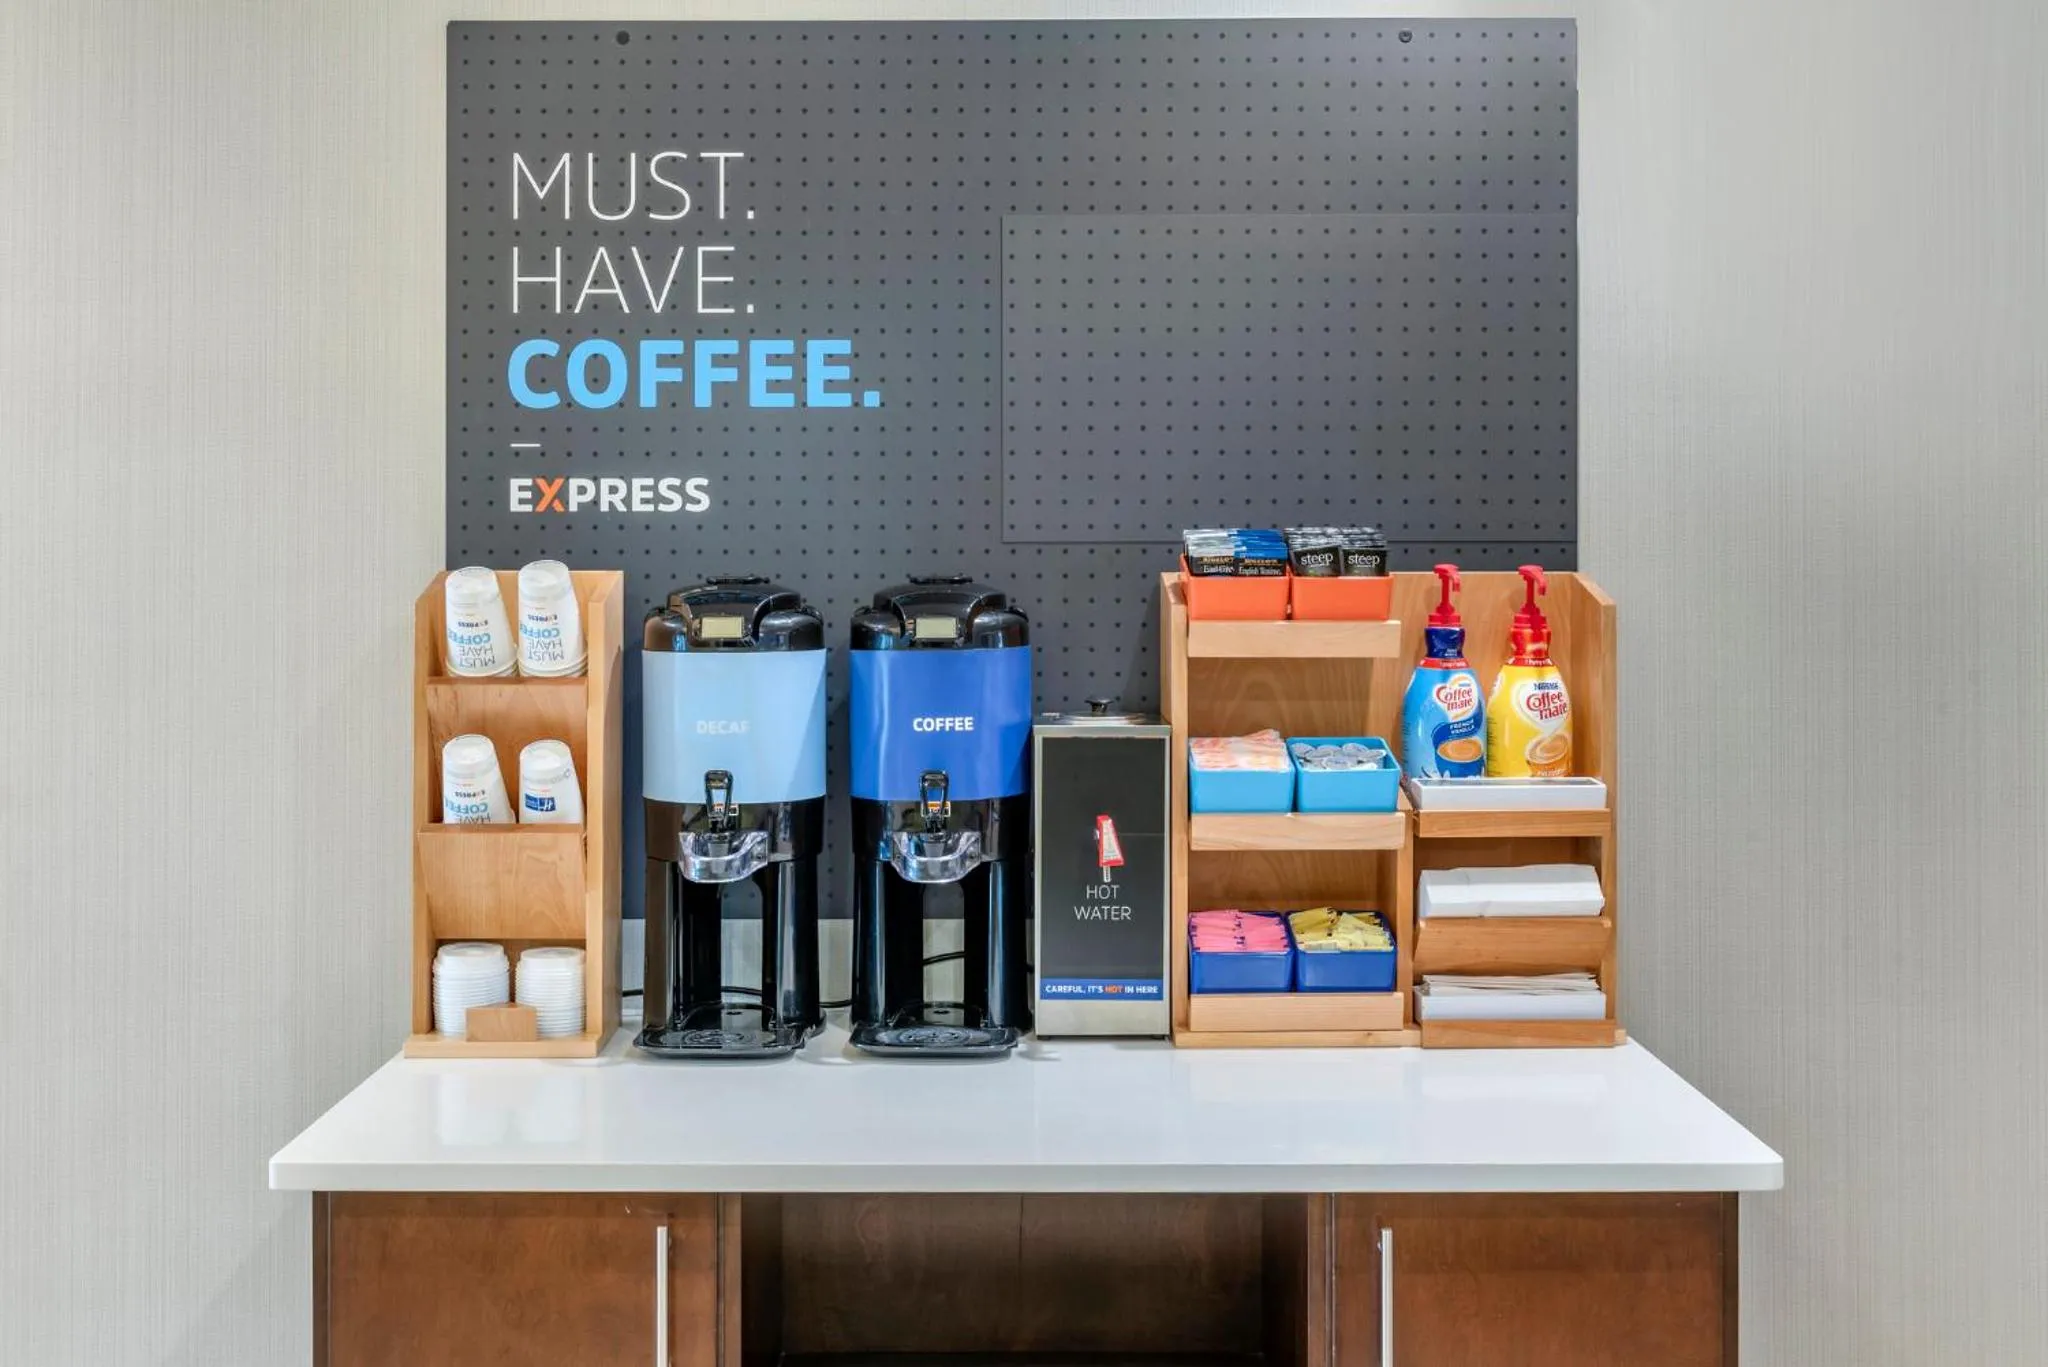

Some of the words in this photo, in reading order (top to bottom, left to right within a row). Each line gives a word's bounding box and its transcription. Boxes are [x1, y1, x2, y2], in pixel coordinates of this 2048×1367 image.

[511, 152, 755, 221] MUST.
[511, 246, 755, 315] HAVE.
[507, 337, 881, 410] COFFEE.
[509, 476, 711, 513] EXPRESS
[1301, 553, 1333, 566] steep
[1348, 554, 1380, 567] steep
[457, 644, 493, 657] HAVE
[527, 638, 562, 650] HAVE
[459, 656, 496, 669] MUST
[528, 650, 565, 662] MUST
[1436, 685, 1473, 704] Coffee
[1526, 691, 1563, 711] Coffee
[1447, 698, 1473, 711] mate
[1539, 703, 1567, 720] mate
[696, 720, 750, 735] DECAF
[912, 716, 975, 733] COFFEE
[1086, 884, 1120, 900] HOT
[1073, 906, 1132, 921] WATER
[1044, 985, 1086, 994] CAREFUL,
[1087, 985, 1104, 993] IT'S
[1105, 985, 1124, 993] HOT
[1125, 985, 1134, 993] IN
[1136, 985, 1158, 993] HERE
